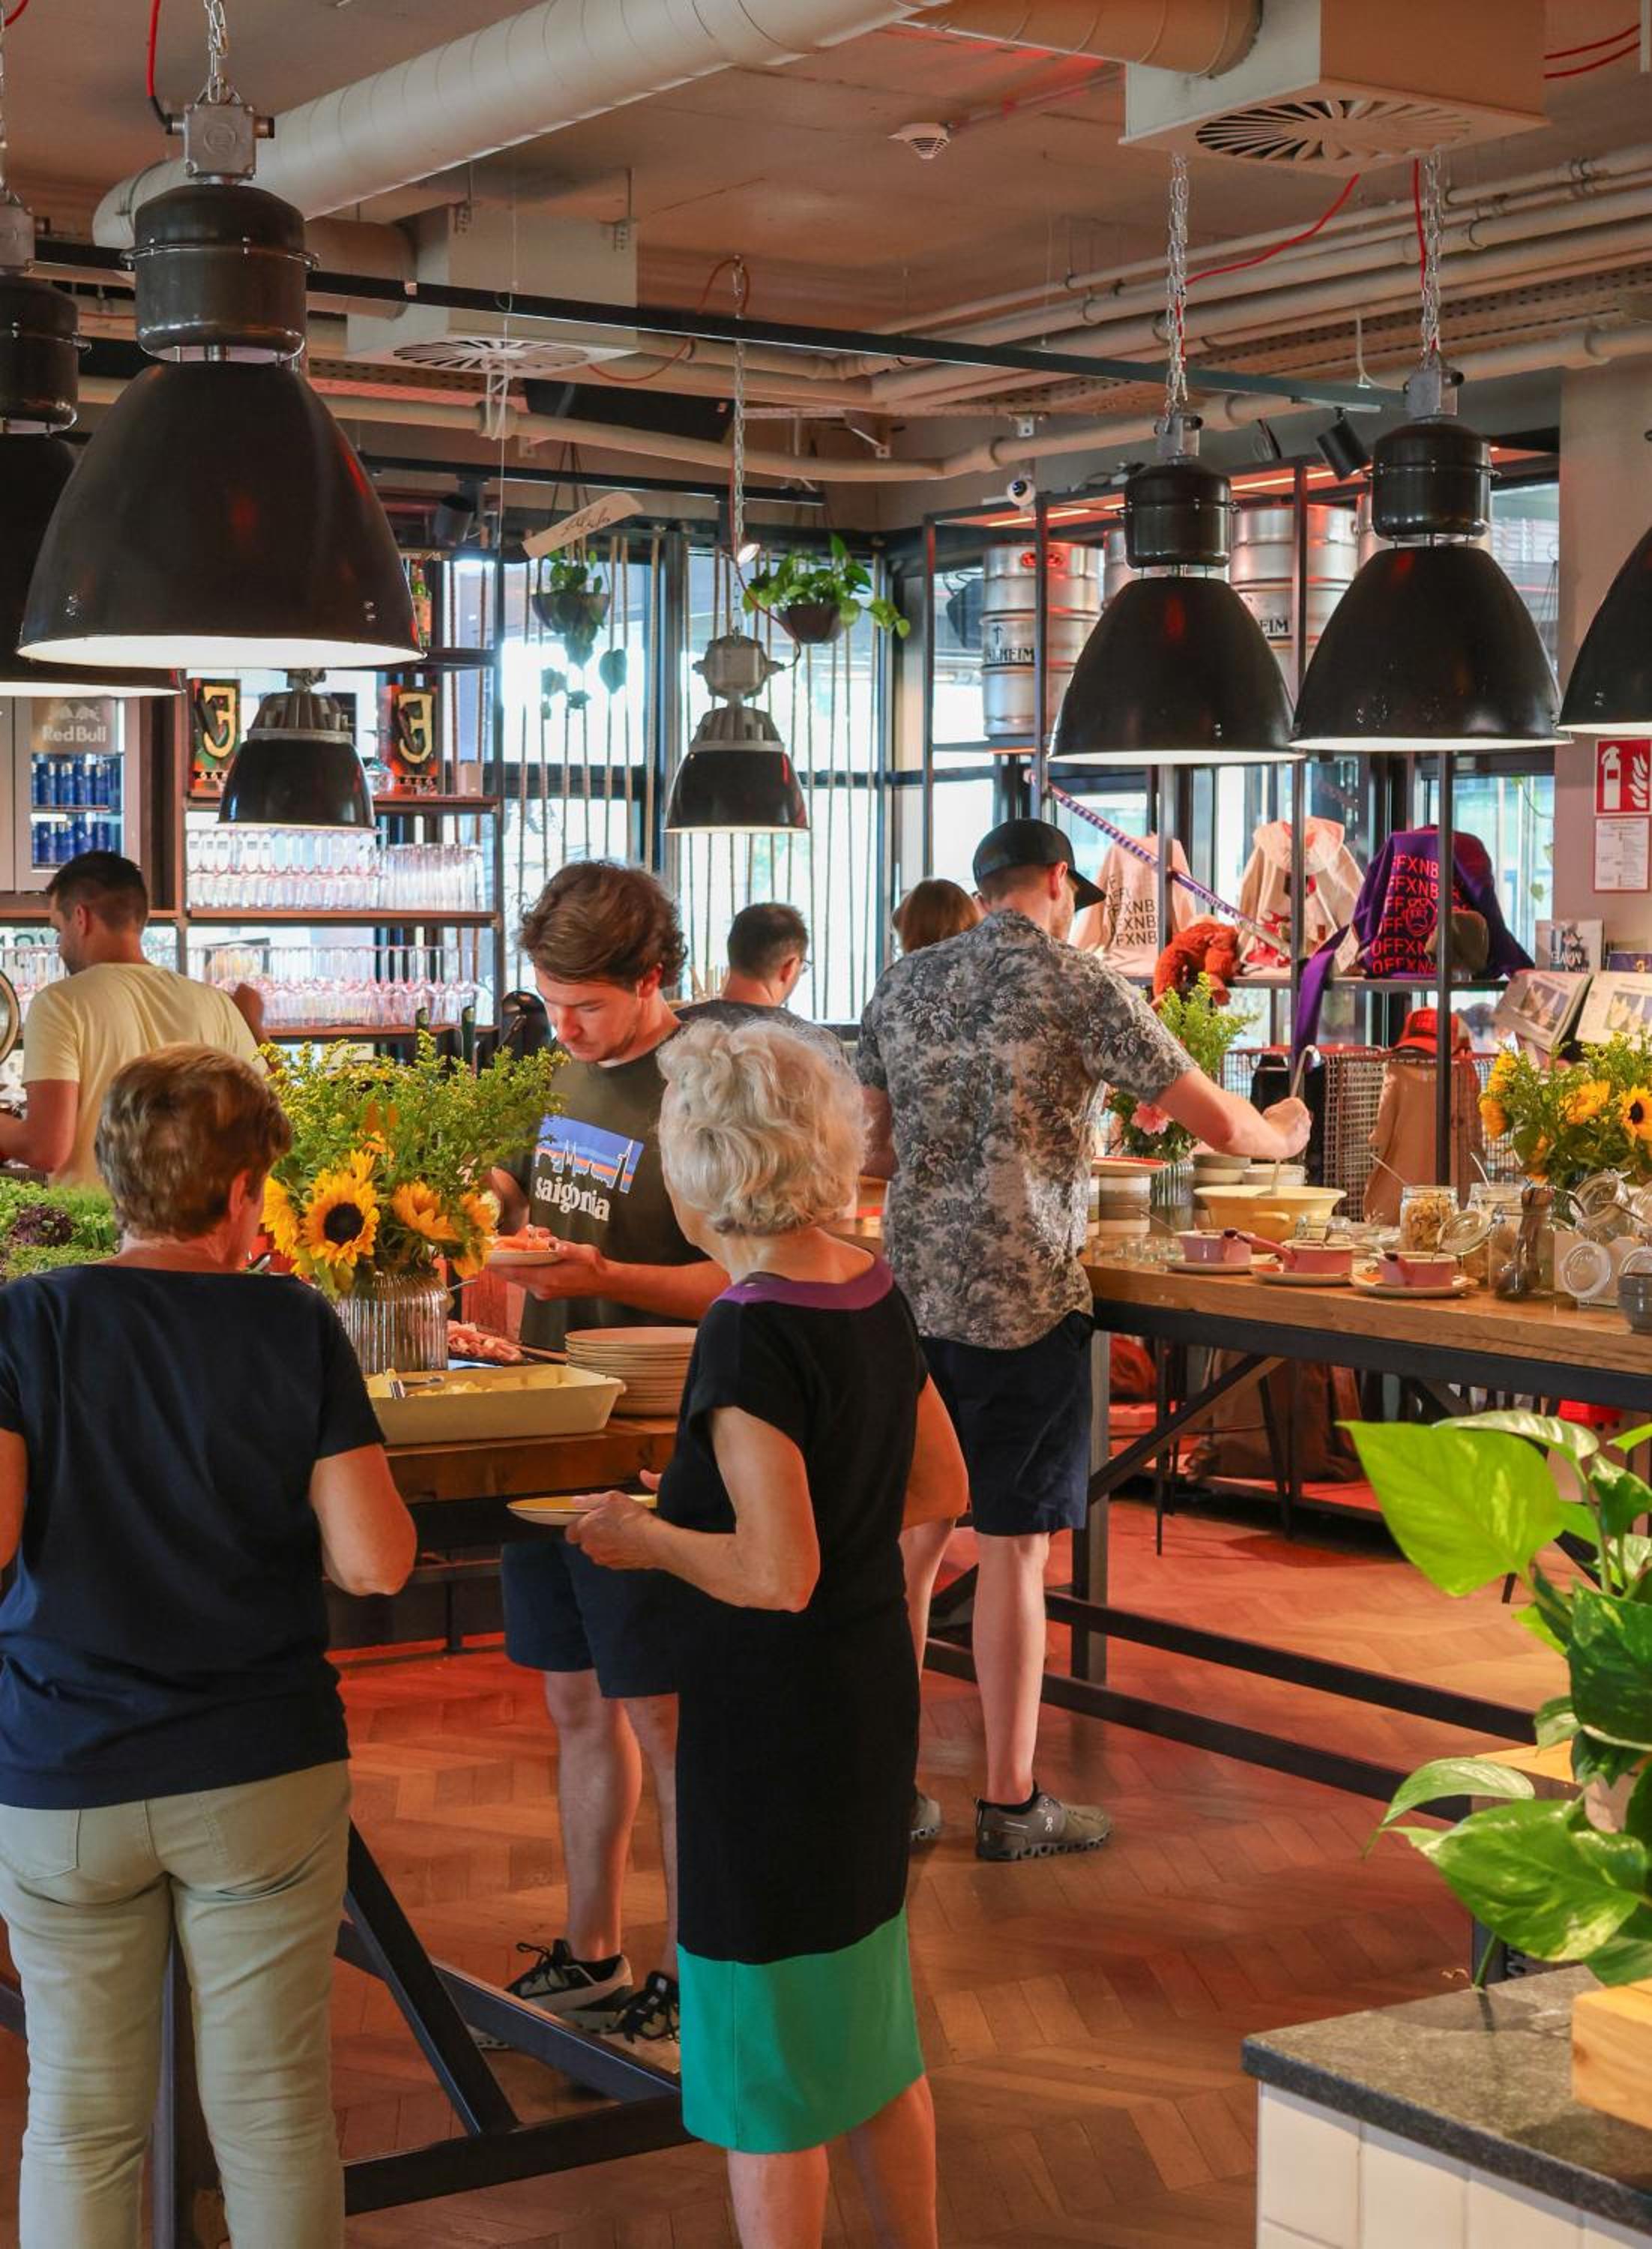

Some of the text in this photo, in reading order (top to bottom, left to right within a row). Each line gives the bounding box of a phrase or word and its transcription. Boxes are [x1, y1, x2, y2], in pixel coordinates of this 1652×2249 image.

[42, 724, 106, 742] Red Bull
[534, 1176, 611, 1222] saigonia
